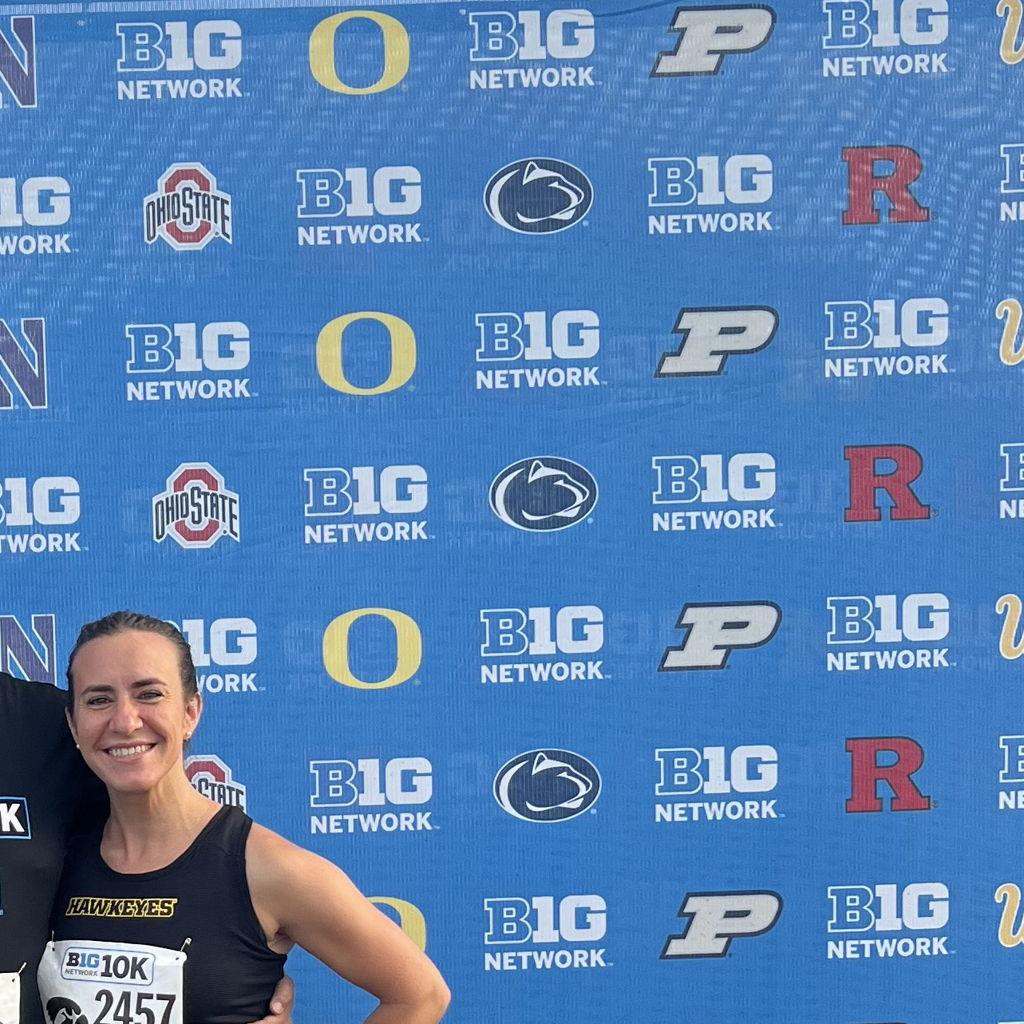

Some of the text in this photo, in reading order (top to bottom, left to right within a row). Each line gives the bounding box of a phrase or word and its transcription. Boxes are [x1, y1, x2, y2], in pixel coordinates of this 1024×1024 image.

[308, 9, 411, 96] O
[651, 5, 775, 78] P
[823, 53, 949, 76] NETWORK
[470, 66, 593, 89] NETWORK
[118, 79, 242, 100] NETWORK
[841, 144, 930, 226] R
[649, 212, 772, 234] NETWORK
[298, 224, 421, 245] NETWORK
[316, 311, 417, 396] O
[656, 307, 779, 378] P
[825, 355, 948, 377] NETWORK
[477, 367, 599, 389] NETWORK
[127, 379, 250, 400] NETWORK
[843, 444, 932, 523] R
[653, 509, 775, 530] NETWORK
[305, 522, 427, 543] NETWORK
[660, 602, 782, 672] P
[322, 608, 423, 690] O
[827, 649, 948, 671] NETWORK
[481, 662, 603, 683] NETWORK
[845, 736, 932, 814] R
[656, 800, 777, 821] NETWORK
[311, 813, 432, 833] NETWORK
[66, 896, 178, 918] HAWKEYES
[662, 892, 782, 959] P
[828, 937, 948, 958] NETWORK
[100, 955, 148, 980] 10K
[485, 949, 605, 970] NETWORK
[64, 968, 98, 977] NETWORK
